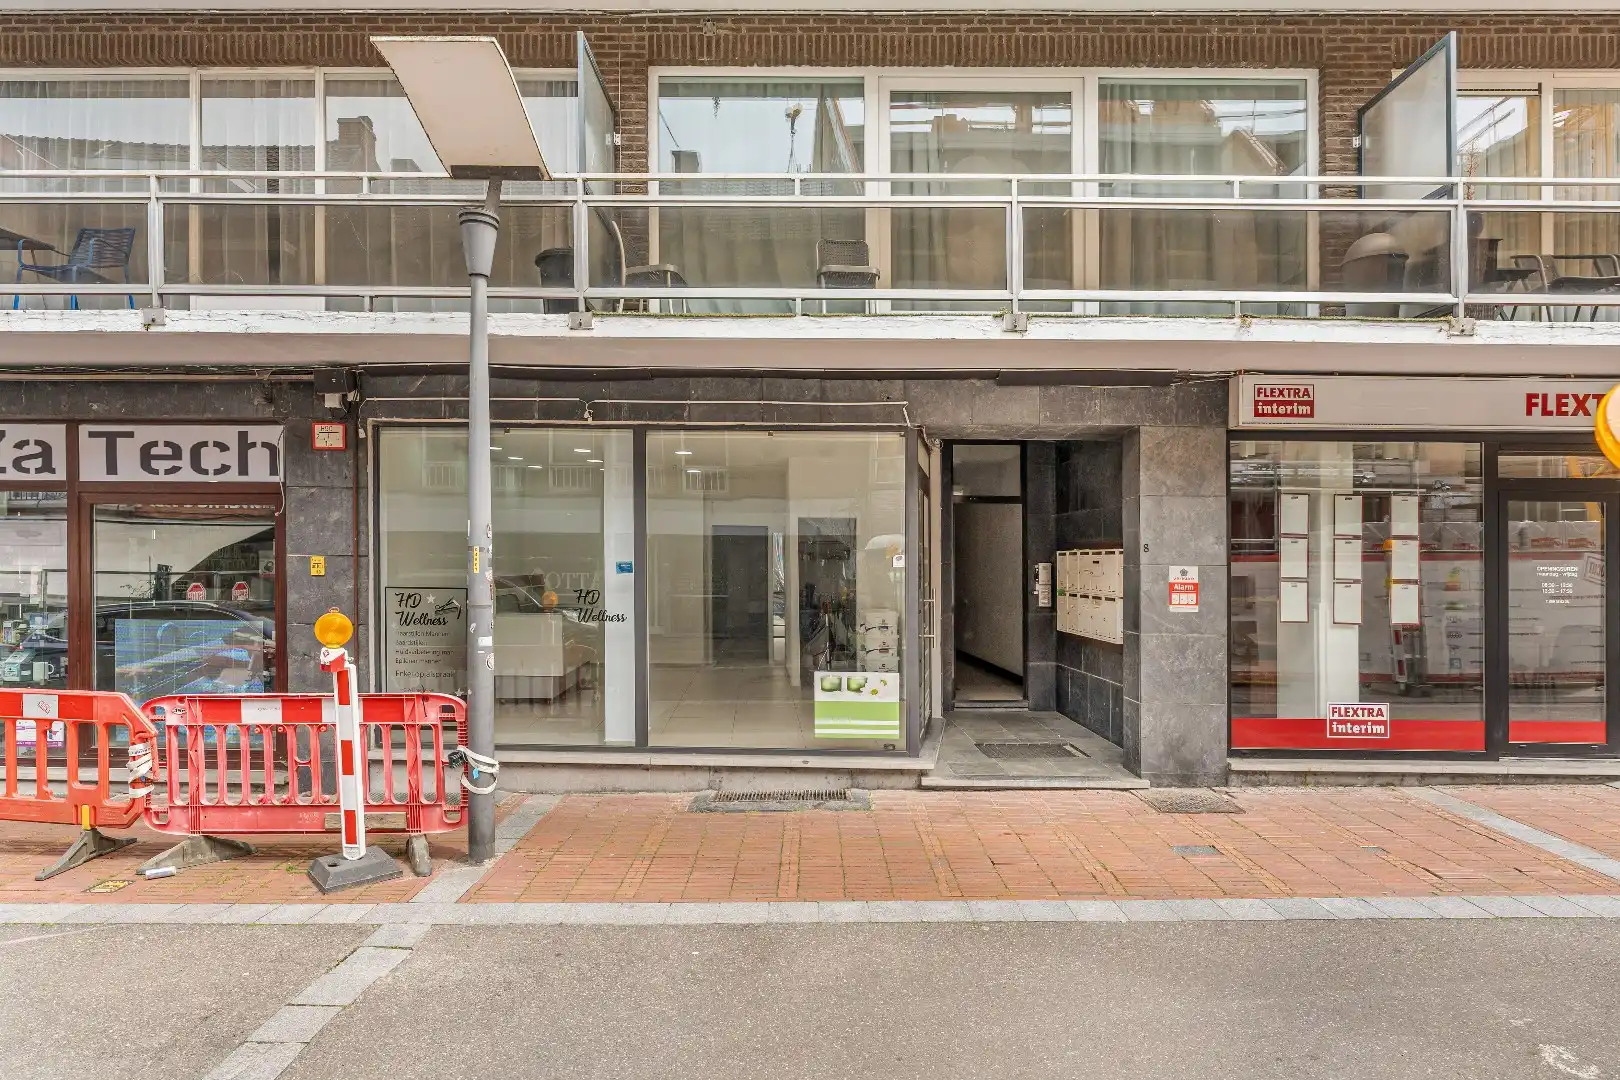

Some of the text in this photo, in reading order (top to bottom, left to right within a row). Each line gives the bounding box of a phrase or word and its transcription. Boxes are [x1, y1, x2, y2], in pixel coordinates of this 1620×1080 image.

[1257, 387, 1311, 398] FLEXTRA
[1258, 402, 1311, 415] interim
[88, 431, 281, 476] Tech
[1143, 543, 1150, 552] 8
[1173, 583, 1195, 591] Alarm
[394, 592, 422, 608] HD
[572, 589, 601, 605] HD
[394, 611, 449, 626] Wellness
[573, 607, 628, 623] Wellness
[1331, 706, 1385, 718] FLEXTRA
[1331, 721, 1385, 734] interim
